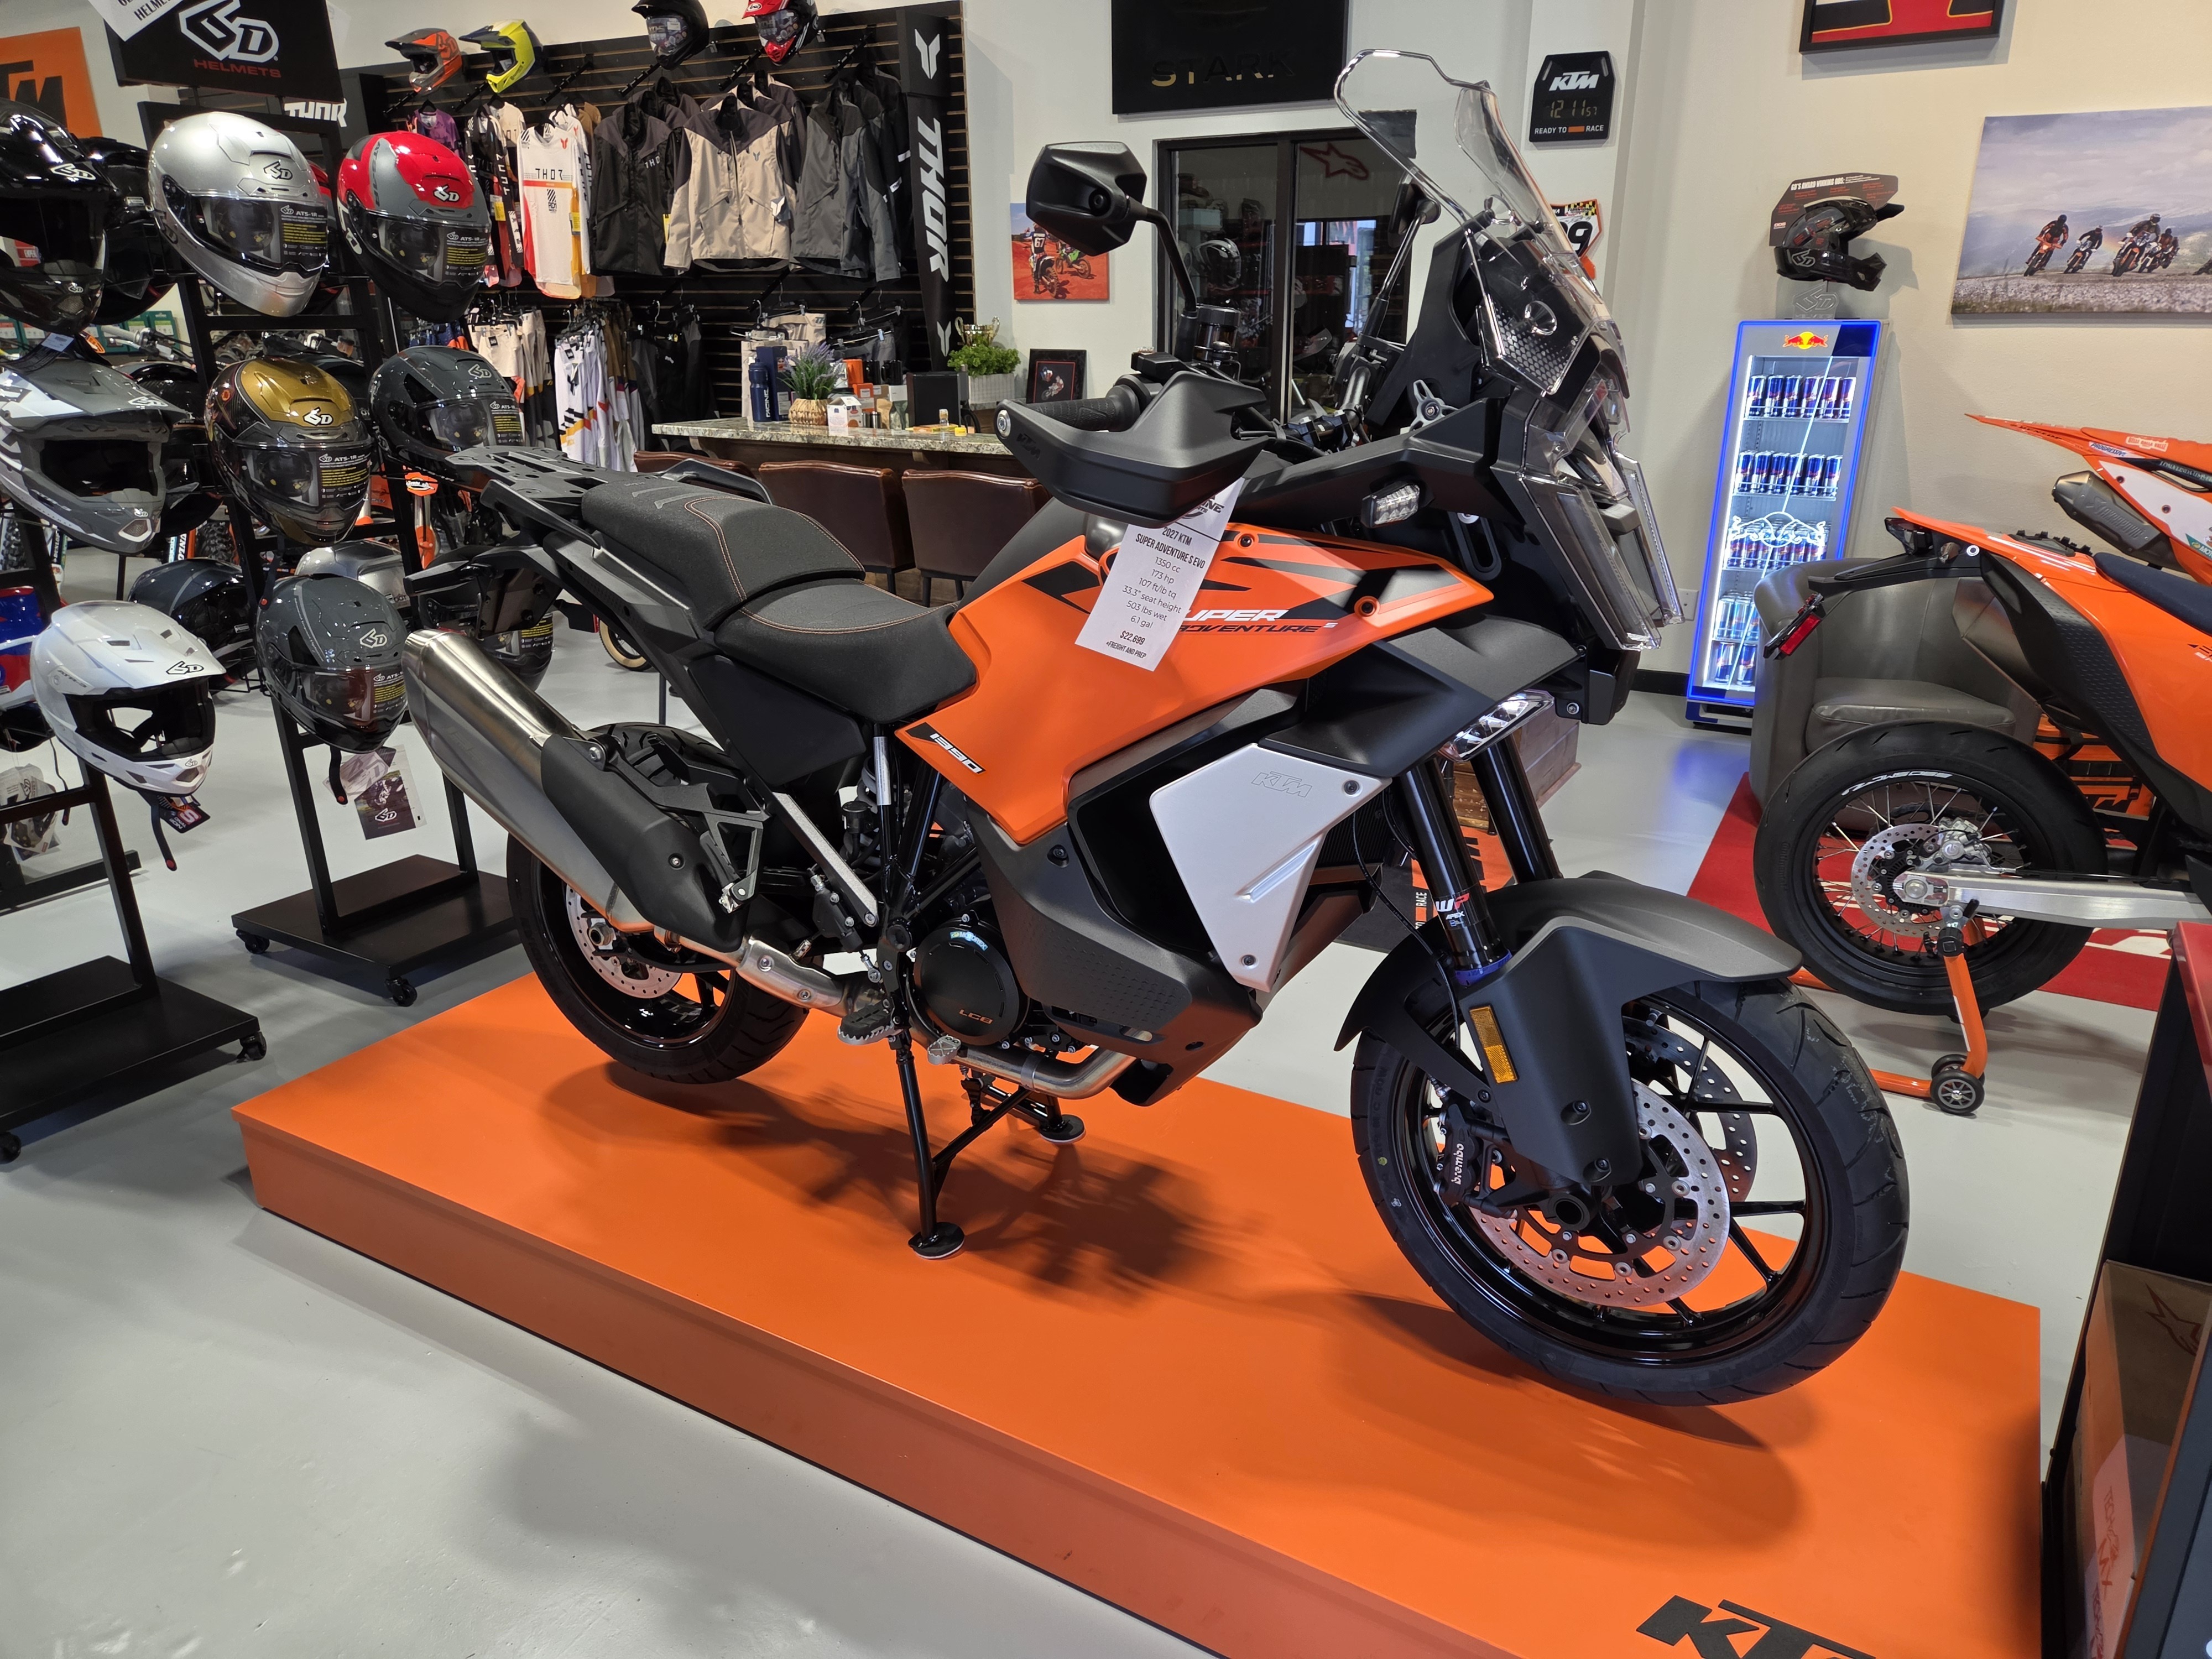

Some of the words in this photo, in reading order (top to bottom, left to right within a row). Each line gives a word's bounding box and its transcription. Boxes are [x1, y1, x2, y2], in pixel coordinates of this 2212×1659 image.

[134, 0, 171, 21] HELME
[179, 0, 279, 62] 6D
[194, 59, 281, 78] HELMETS
[1549, 71, 1600, 91] KTM
[264, 159, 293, 180] 6D
[434, 184, 460, 202] 6D
[917, 116, 950, 282] THOR
[1034, 237, 1045, 248] 67
[468, 364, 492, 378] 6D
[302, 406, 333, 426] 6D
[2090, 442, 2127, 457] PROGRESSIVE
[1162, 526, 1179, 540] 2027
[1179, 533, 1192, 546] KTM
[1135, 533, 1155, 548] SUPER
[1155, 541, 1190, 562] ADVENTURE
[1192, 558, 1206, 569] EVO
[1155, 556, 1171, 569] 1350
[1172, 565, 1181, 573] cc
[1151, 569, 1164, 580] 173
[1164, 572, 1175, 585] hp
[1139, 577, 1152, 588] 107
[1152, 582, 1167, 595] ft/lb
[1168, 590, 1177, 599] tq
[1126, 600, 1141, 611] 503
[1141, 605, 1152, 615] lbs
[1154, 612, 1167, 622] wet
[1141, 592, 1157, 604] seat
[1158, 599, 1182, 613] height
[1130, 615, 1140, 623] 6.1
[1140, 619, 1154, 629] gal
[1183, 609, 1289, 621] UPER
[360, 628, 387, 648] 6D
[1120, 630, 1145, 645] $22,699
[1179, 624, 1322, 633] ADVENTURE
[1126, 646, 1136, 655] AND
[1135, 650, 1147, 659] PREP
[166, 661, 204, 675] 6D
[930, 733, 983, 773] 1390
[1251, 770, 1312, 798] KTM
[375, 808, 397, 822] 6D
[1416, 892, 1427, 907] RACE
[1436, 893, 1470, 912] WP
[1446, 911, 1465, 920] APEX
[959, 931, 988, 951] MOTOREX
[959, 1009, 993, 1024] LC8
[1451, 1143, 1464, 1185] brembo
[1636, 1595, 1877, 1659] KT
